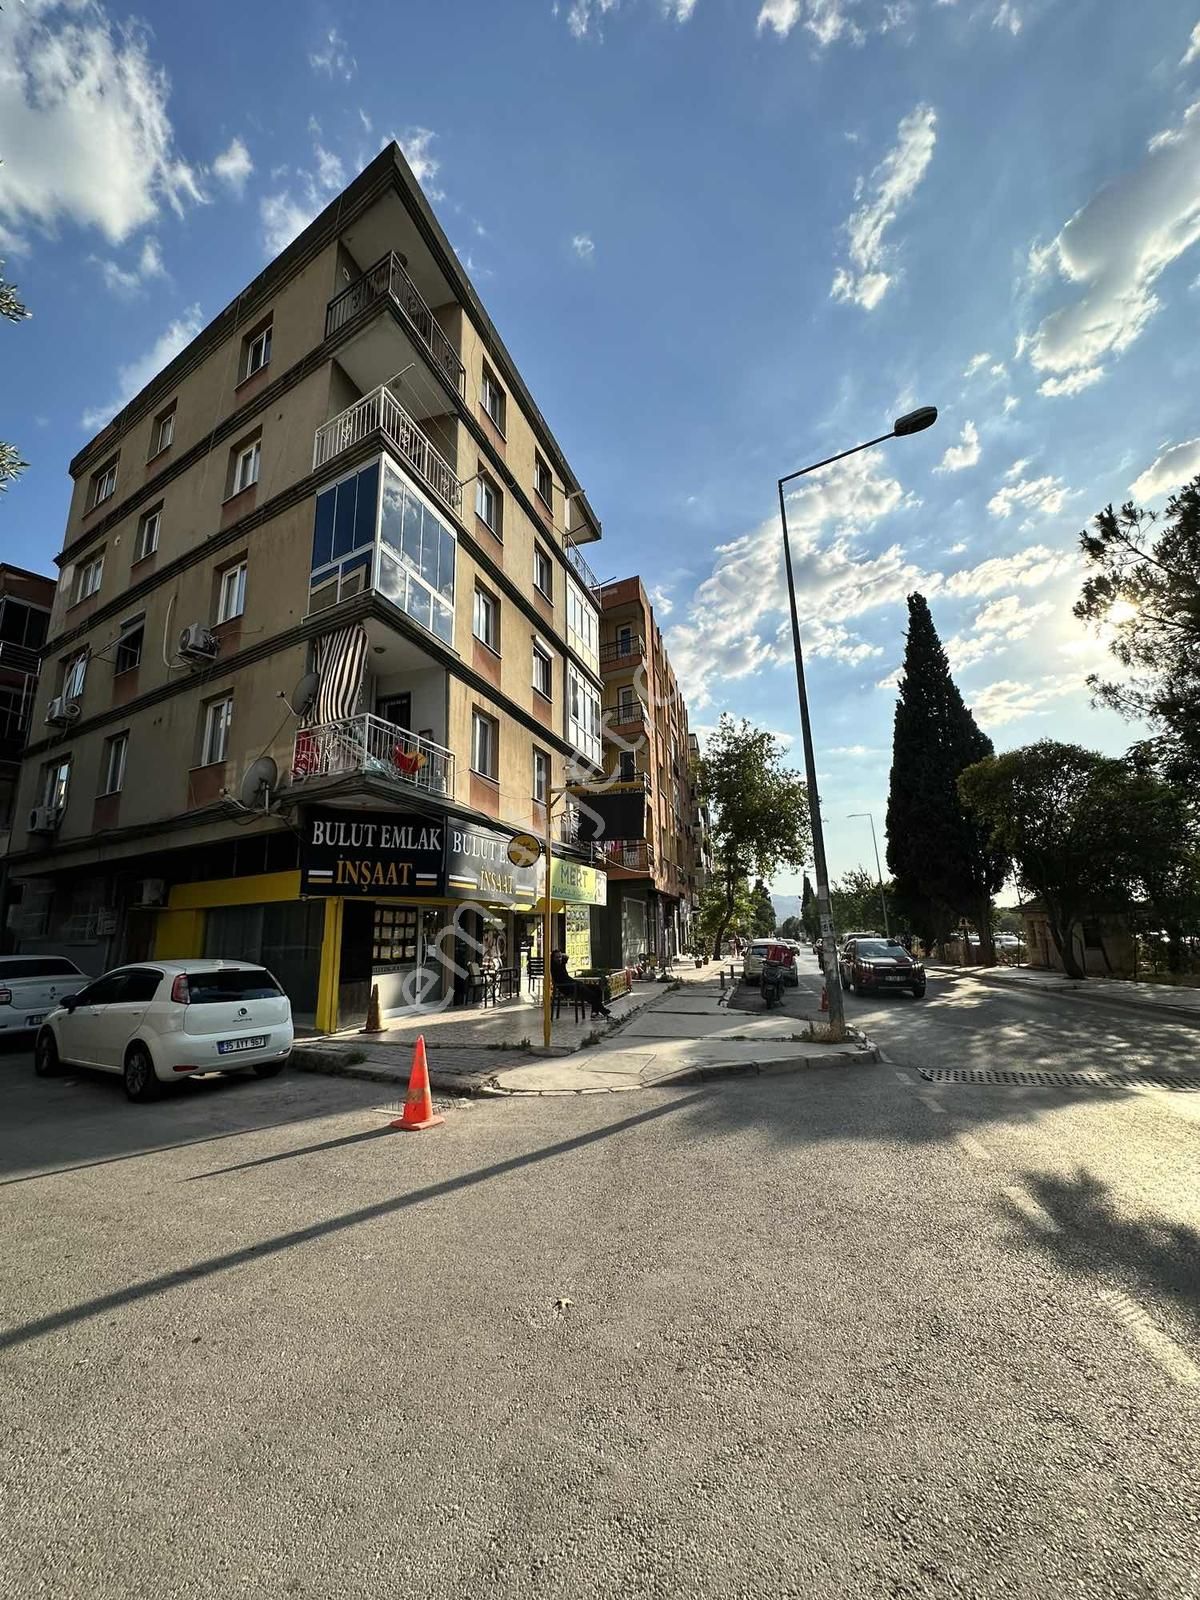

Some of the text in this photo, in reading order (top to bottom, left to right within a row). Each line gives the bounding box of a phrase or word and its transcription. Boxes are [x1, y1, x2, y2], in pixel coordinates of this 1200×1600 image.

[312, 820, 441, 850] BULUT EMLAK
[453, 831, 497, 861] BULUT
[336, 854, 412, 892] İNŞAAT
[560, 864, 588, 889] MERT
[224, 1040, 233, 1050] 35
